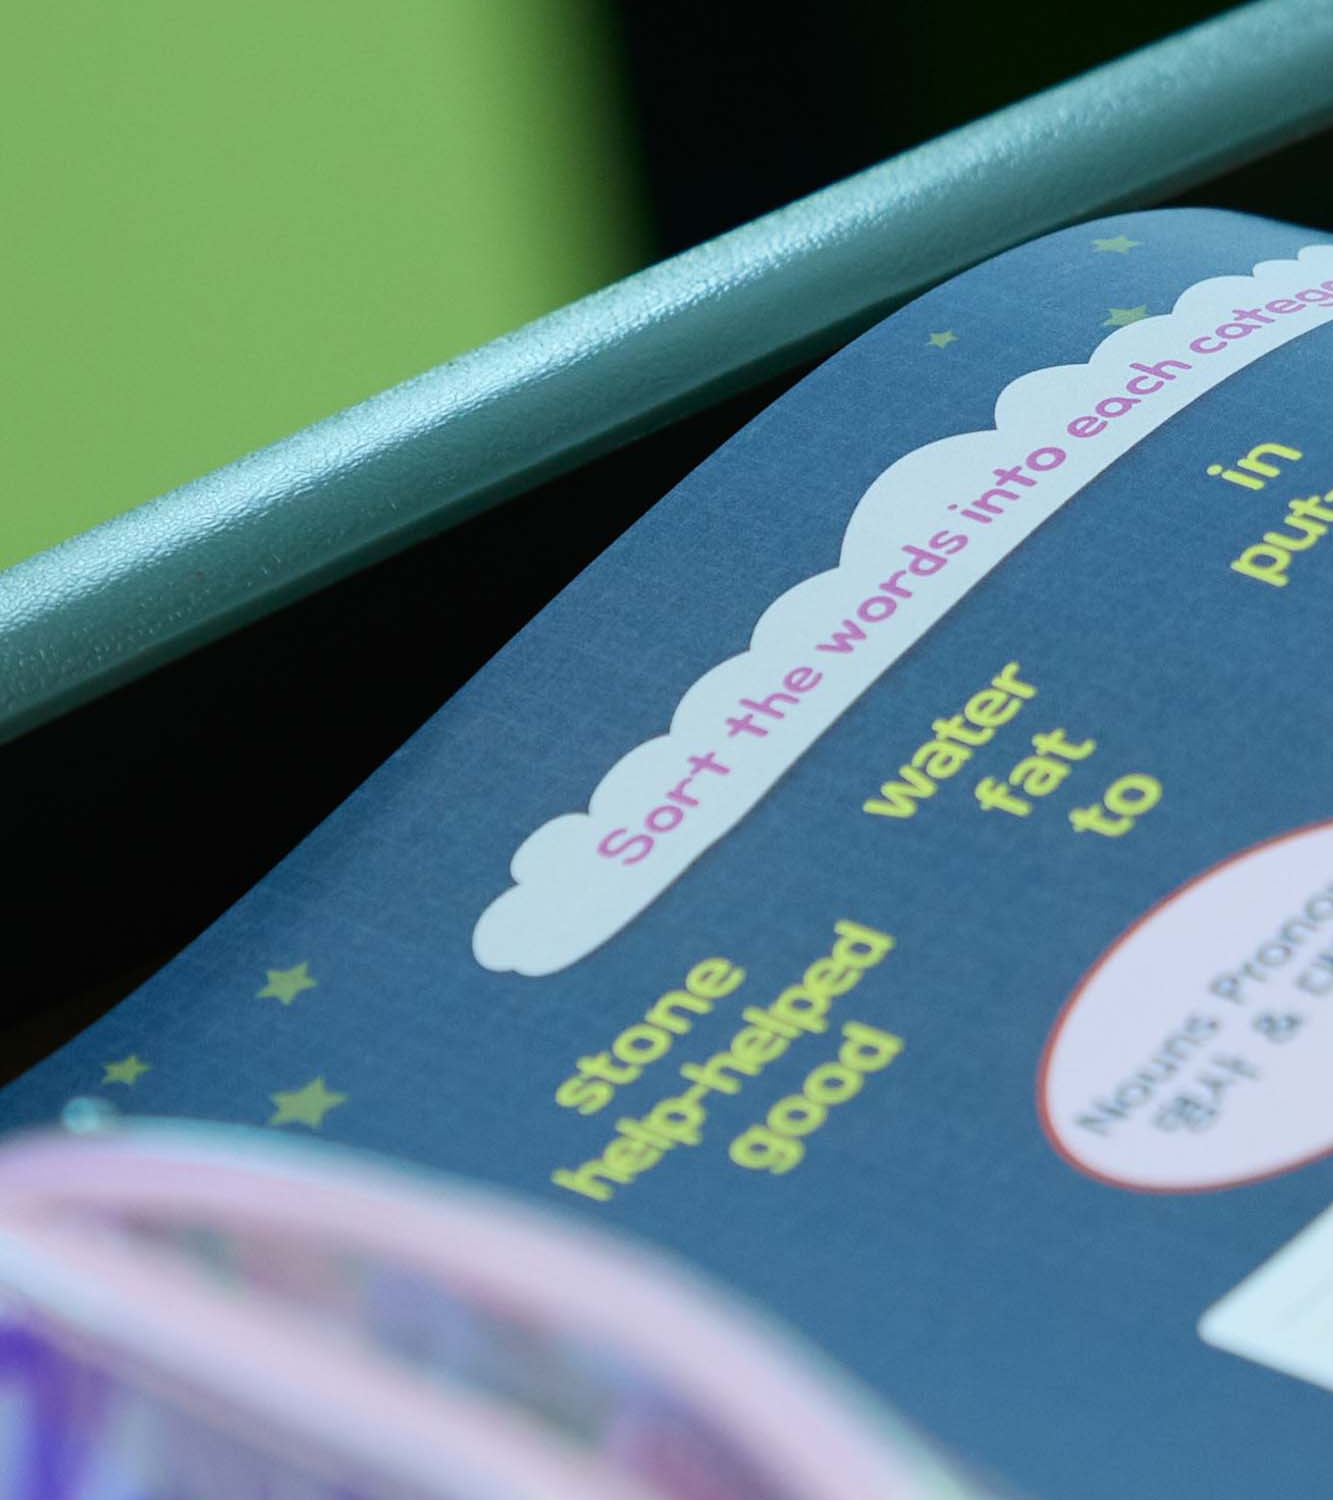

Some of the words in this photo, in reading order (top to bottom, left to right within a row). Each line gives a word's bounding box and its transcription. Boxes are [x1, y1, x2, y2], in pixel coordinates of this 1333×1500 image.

[1206, 439, 1303, 490] in
[597, 751, 730, 866] Sort
[725, 666, 823, 738] the
[815, 526, 969, 657] words
[946, 440, 1068, 525] into
[1066, 358, 1192, 440] each
[862, 660, 1037, 818] water
[974, 727, 1096, 816] fat
[1068, 772, 1163, 837] to
[551, 919, 895, 1201] help-helped
[554, 957, 746, 1115] stone
[1075, 1012, 1221, 1137] Nouns
[1251, 1008, 1302, 1043] &
[729, 1020, 904, 1175] good
